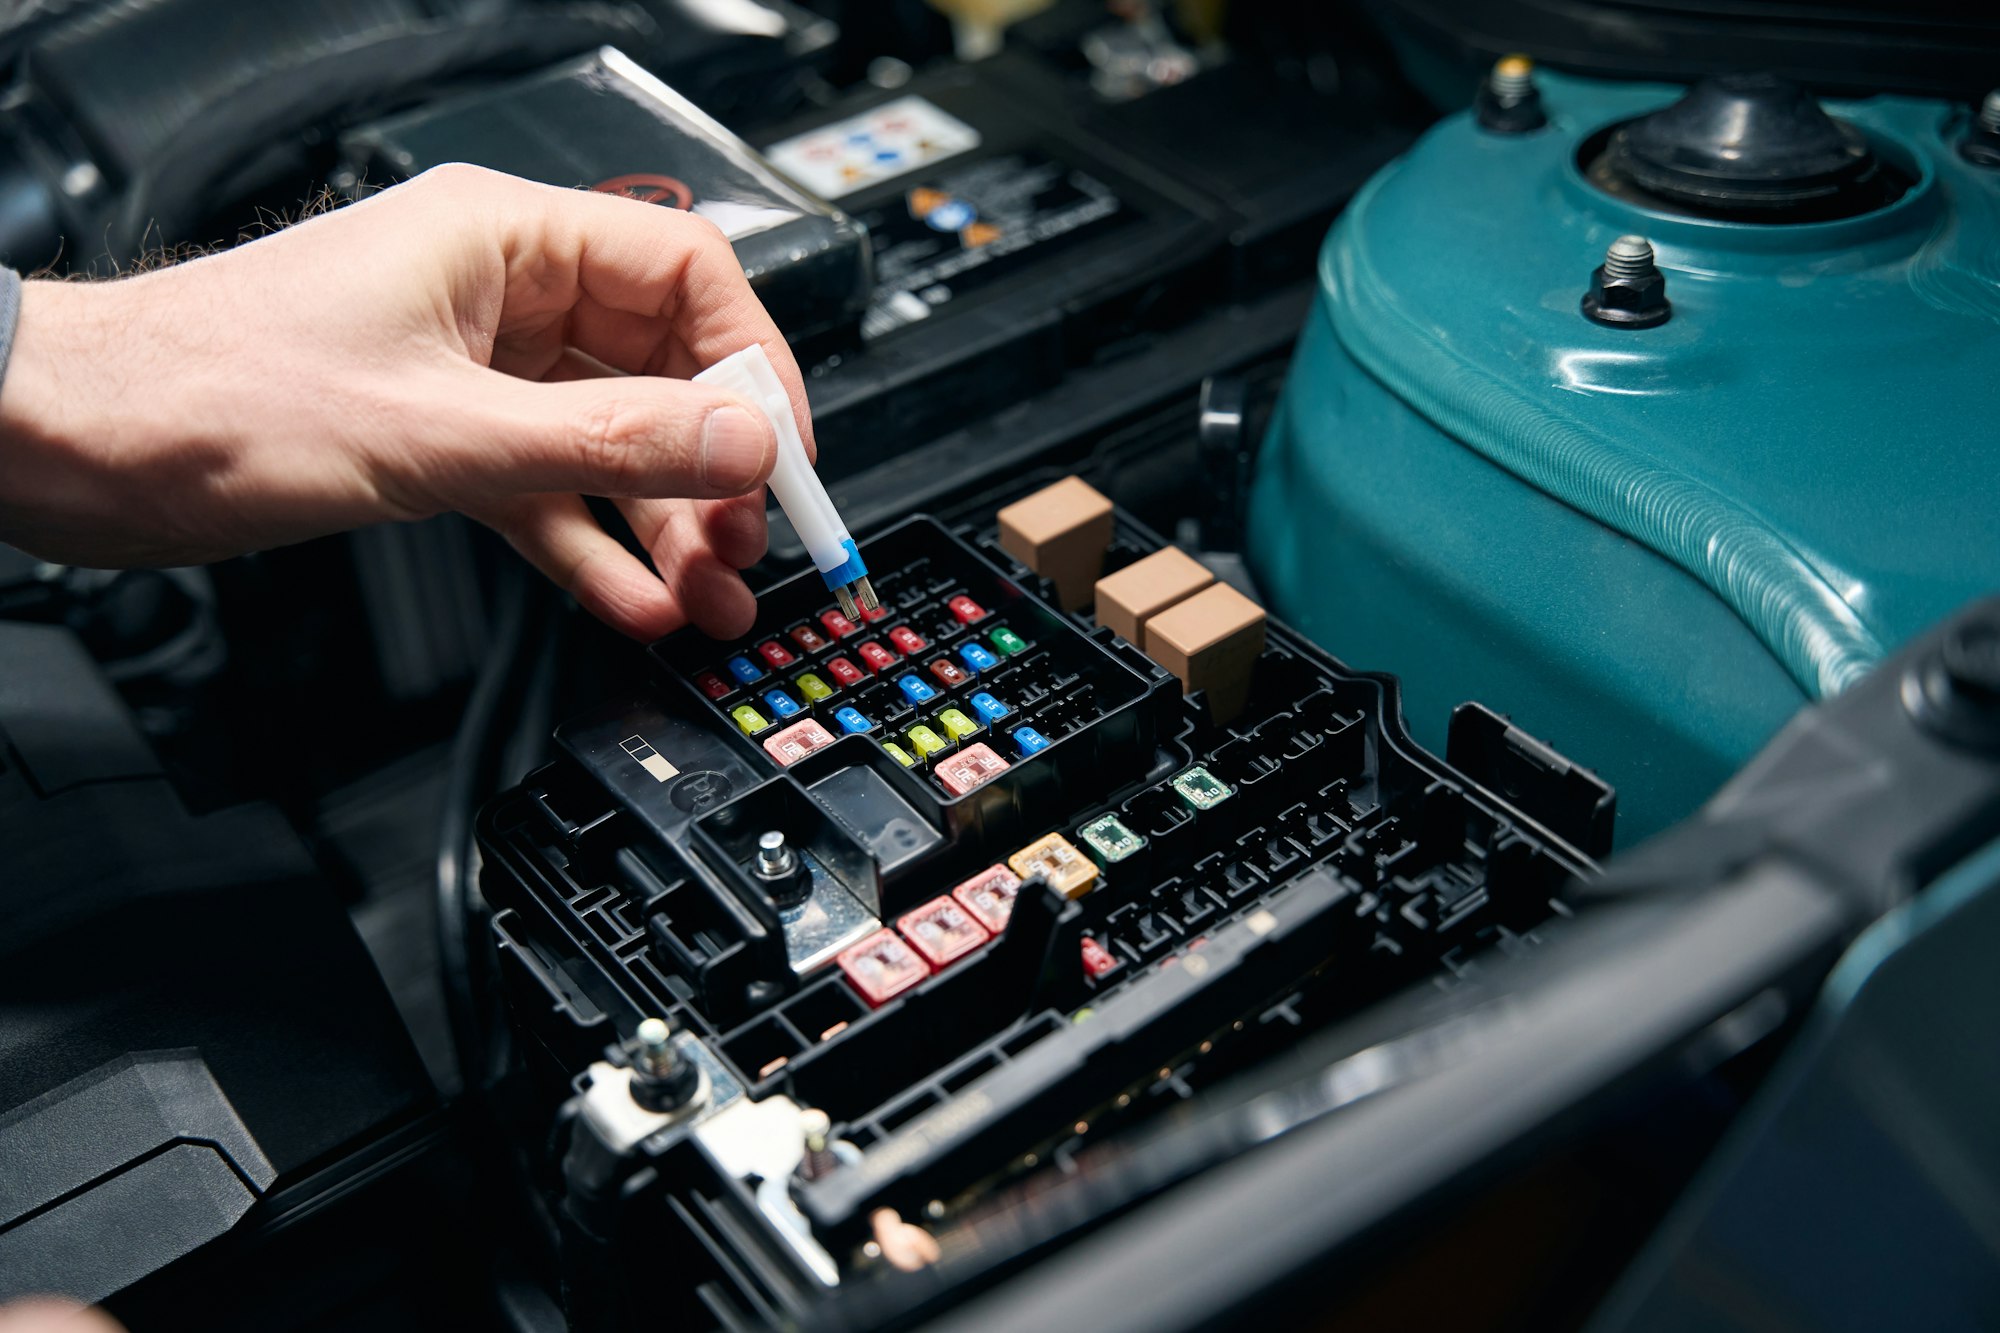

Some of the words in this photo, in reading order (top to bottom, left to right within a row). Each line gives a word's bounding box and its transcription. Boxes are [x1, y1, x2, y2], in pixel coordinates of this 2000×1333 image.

[769, 648, 784, 659] 10
[871, 648, 886, 660] 10
[971, 651, 986, 661] 15
[740, 664, 753, 675] 15
[838, 665, 852, 676] 10
[809, 680, 823, 690] 20
[910, 683, 925, 693] 15
[775, 697, 789, 708] 15
[984, 700, 998, 710] 15
[744, 712, 758, 723] 20
[848, 713, 862, 725] 15
[952, 716, 966, 727] 20
[807, 729, 827, 744] 30
[921, 733, 933, 744] 20
[1027, 734, 1042, 745] 15
[782, 742, 800, 757] 30
[980, 755, 1000, 769] 30
[955, 768, 977, 783] 30
[1204, 787, 1219, 797] 40
